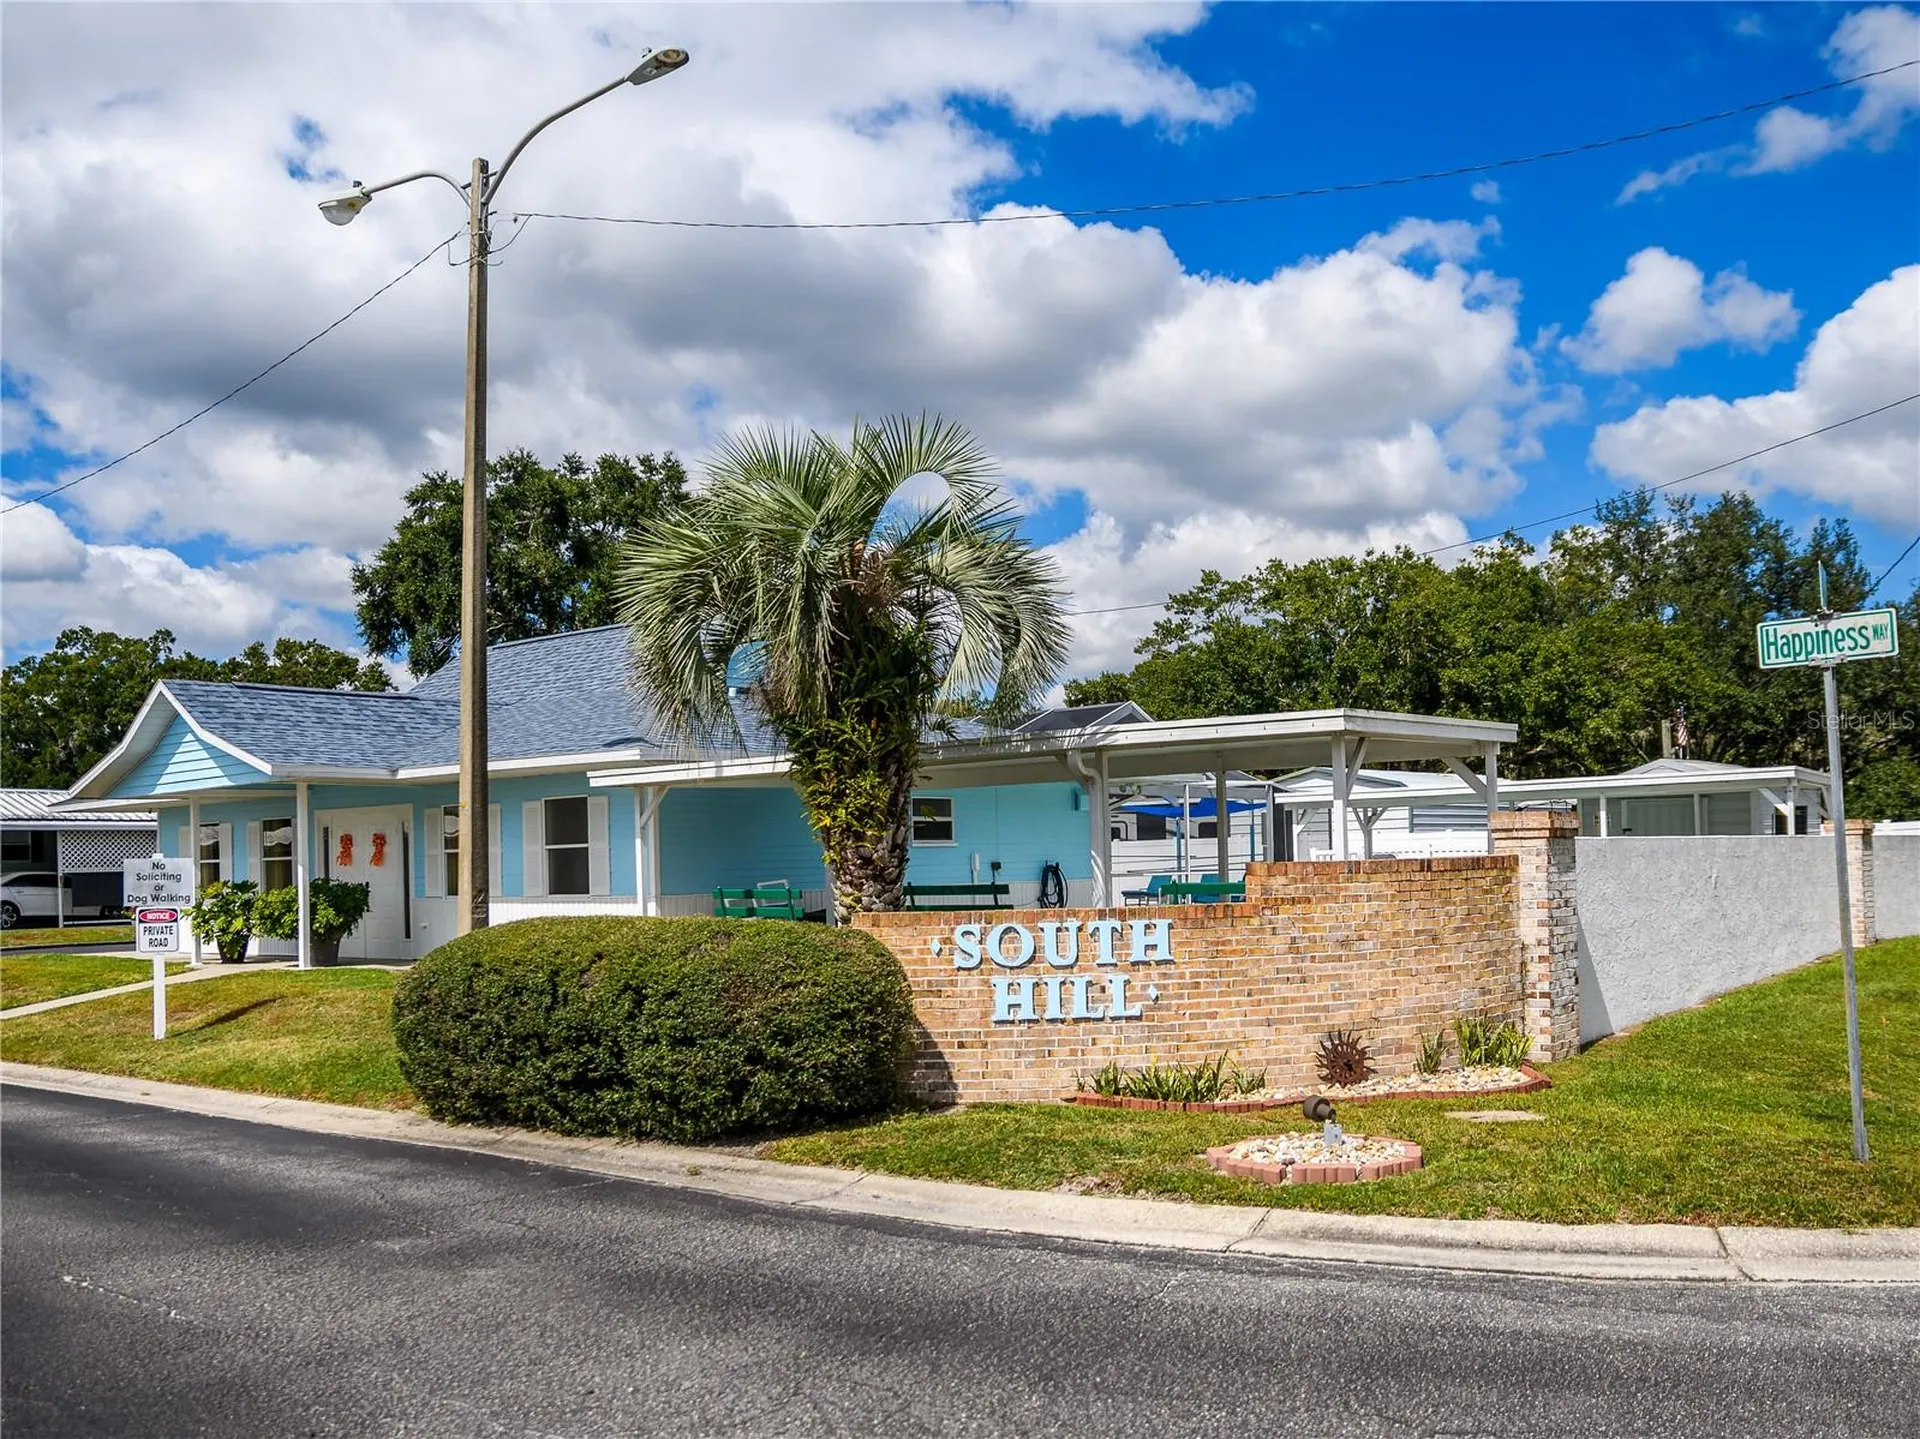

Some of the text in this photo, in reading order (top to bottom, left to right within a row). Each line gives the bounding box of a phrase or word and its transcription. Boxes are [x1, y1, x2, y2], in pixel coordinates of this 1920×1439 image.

[1765, 623, 1889, 662] Happiness WAY
[152, 862, 166, 870] No
[136, 872, 182, 882] Soliciting
[127, 894, 191, 904] Dog Walking
[147, 912, 170, 920] NOTICE
[143, 926, 174, 936] PRIVATE
[148, 938, 169, 947] ROAD
[953, 919, 1176, 971] SOUTH
[992, 974, 1143, 1024] HILL
